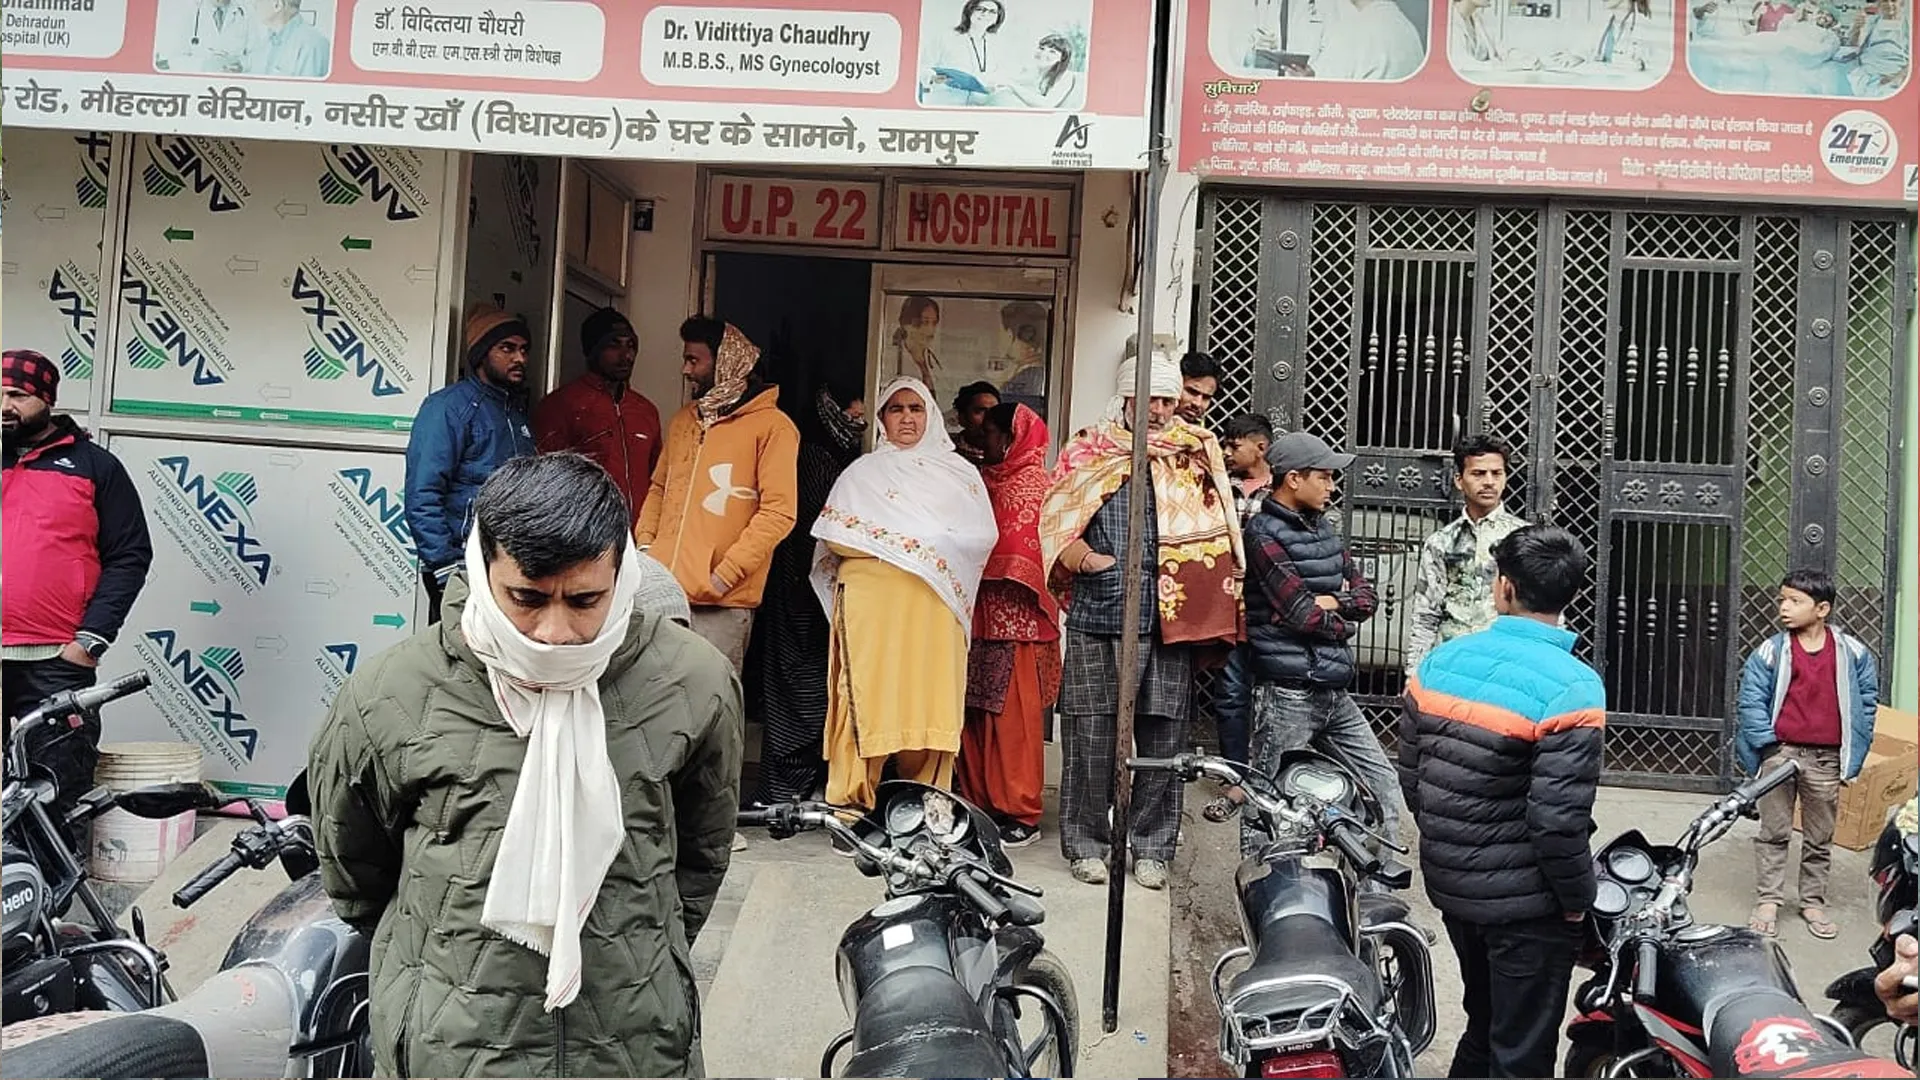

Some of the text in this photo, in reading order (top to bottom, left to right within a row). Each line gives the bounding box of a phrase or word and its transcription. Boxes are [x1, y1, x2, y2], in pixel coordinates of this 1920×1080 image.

[6, 13, 66, 29] Dehradun
[43, 31, 70, 48] (UK)
[374, 7, 394, 31] डॉ.
[478, 9, 525, 36] चौधरी
[663, 19, 871, 51] Dr. Vidittiya Chaudhry
[739, 53, 764, 71] MS
[769, 54, 881, 80] Gynecologyst
[15, 78, 69, 114] रोड,
[81, 80, 190, 118] मौहल्ला
[325, 93, 409, 129] नसीर
[414, 99, 465, 132] खाँ
[668, 119, 714, 146] घर
[720, 112, 755, 147] के
[763, 116, 866, 154] सामने,
[878, 126, 979, 166] रामपुर
[1829, 153, 1889, 166] Emergency
[207, 149, 251, 199] ALUMINIUM
[331, 143, 419, 220] ANE
[385, 156, 429, 207] ALUMINIUM
[721, 183, 1057, 249] U.P. 22 HOSPITAL
[119, 258, 225, 385] ANEXA
[130, 246, 237, 373] ALUMINIUM COMPOSITE PANEL
[291, 266, 404, 394] ANEXA
[307, 256, 415, 383] ALUMINIUM COMPOSITE PANEL
[146, 468, 191, 519] ALUMINIUM
[187, 517, 232, 569] COMPOSITE
[228, 566, 255, 597] PANEL
[157, 456, 273, 586] ANEXA
[328, 479, 373, 532] ALUMINIUM
[370, 529, 415, 581] COMPOSITE
[339, 469, 418, 557] ANE
[133, 642, 242, 772] ALUMINIUM COMPOSITE PANEL
[145, 631, 259, 761] ANEXA
[2, 886, 33, 915] Hero
